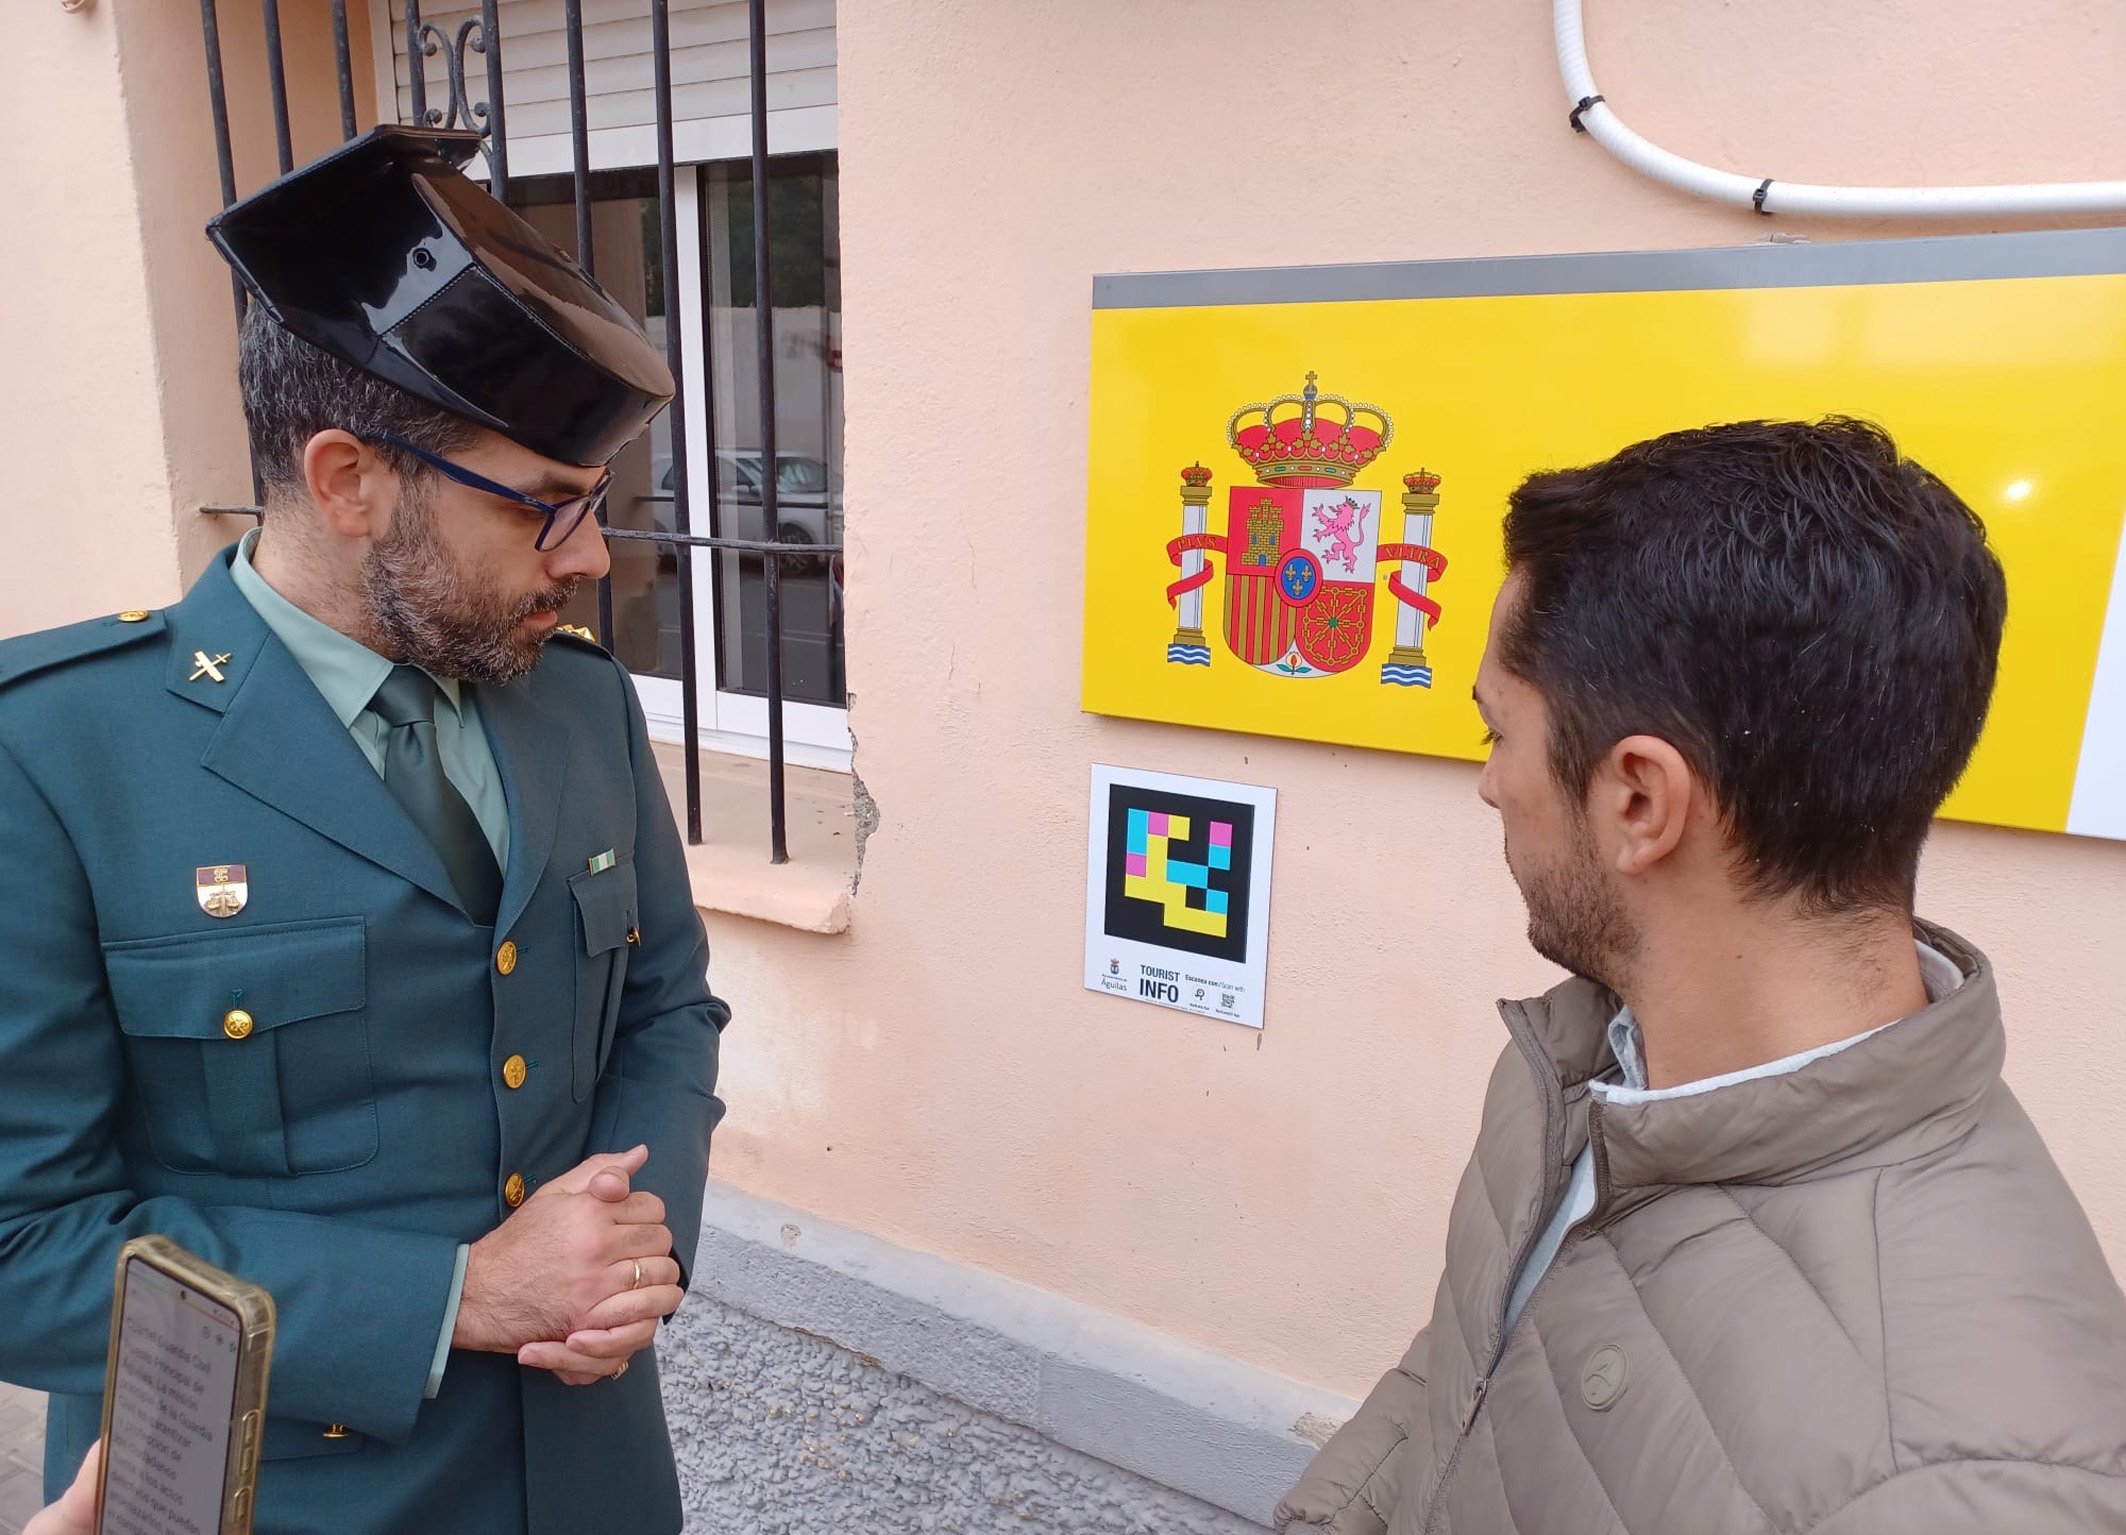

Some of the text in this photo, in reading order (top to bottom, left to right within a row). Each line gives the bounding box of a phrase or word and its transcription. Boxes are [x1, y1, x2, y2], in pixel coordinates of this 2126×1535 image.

[1177, 536, 1216, 551] PLVS
[1385, 546, 1441, 570] VLTRA
[1140, 964, 1180, 982] TOURIST
[1101, 978, 1127, 992] Águilas
[1139, 978, 1179, 1003] INFO
